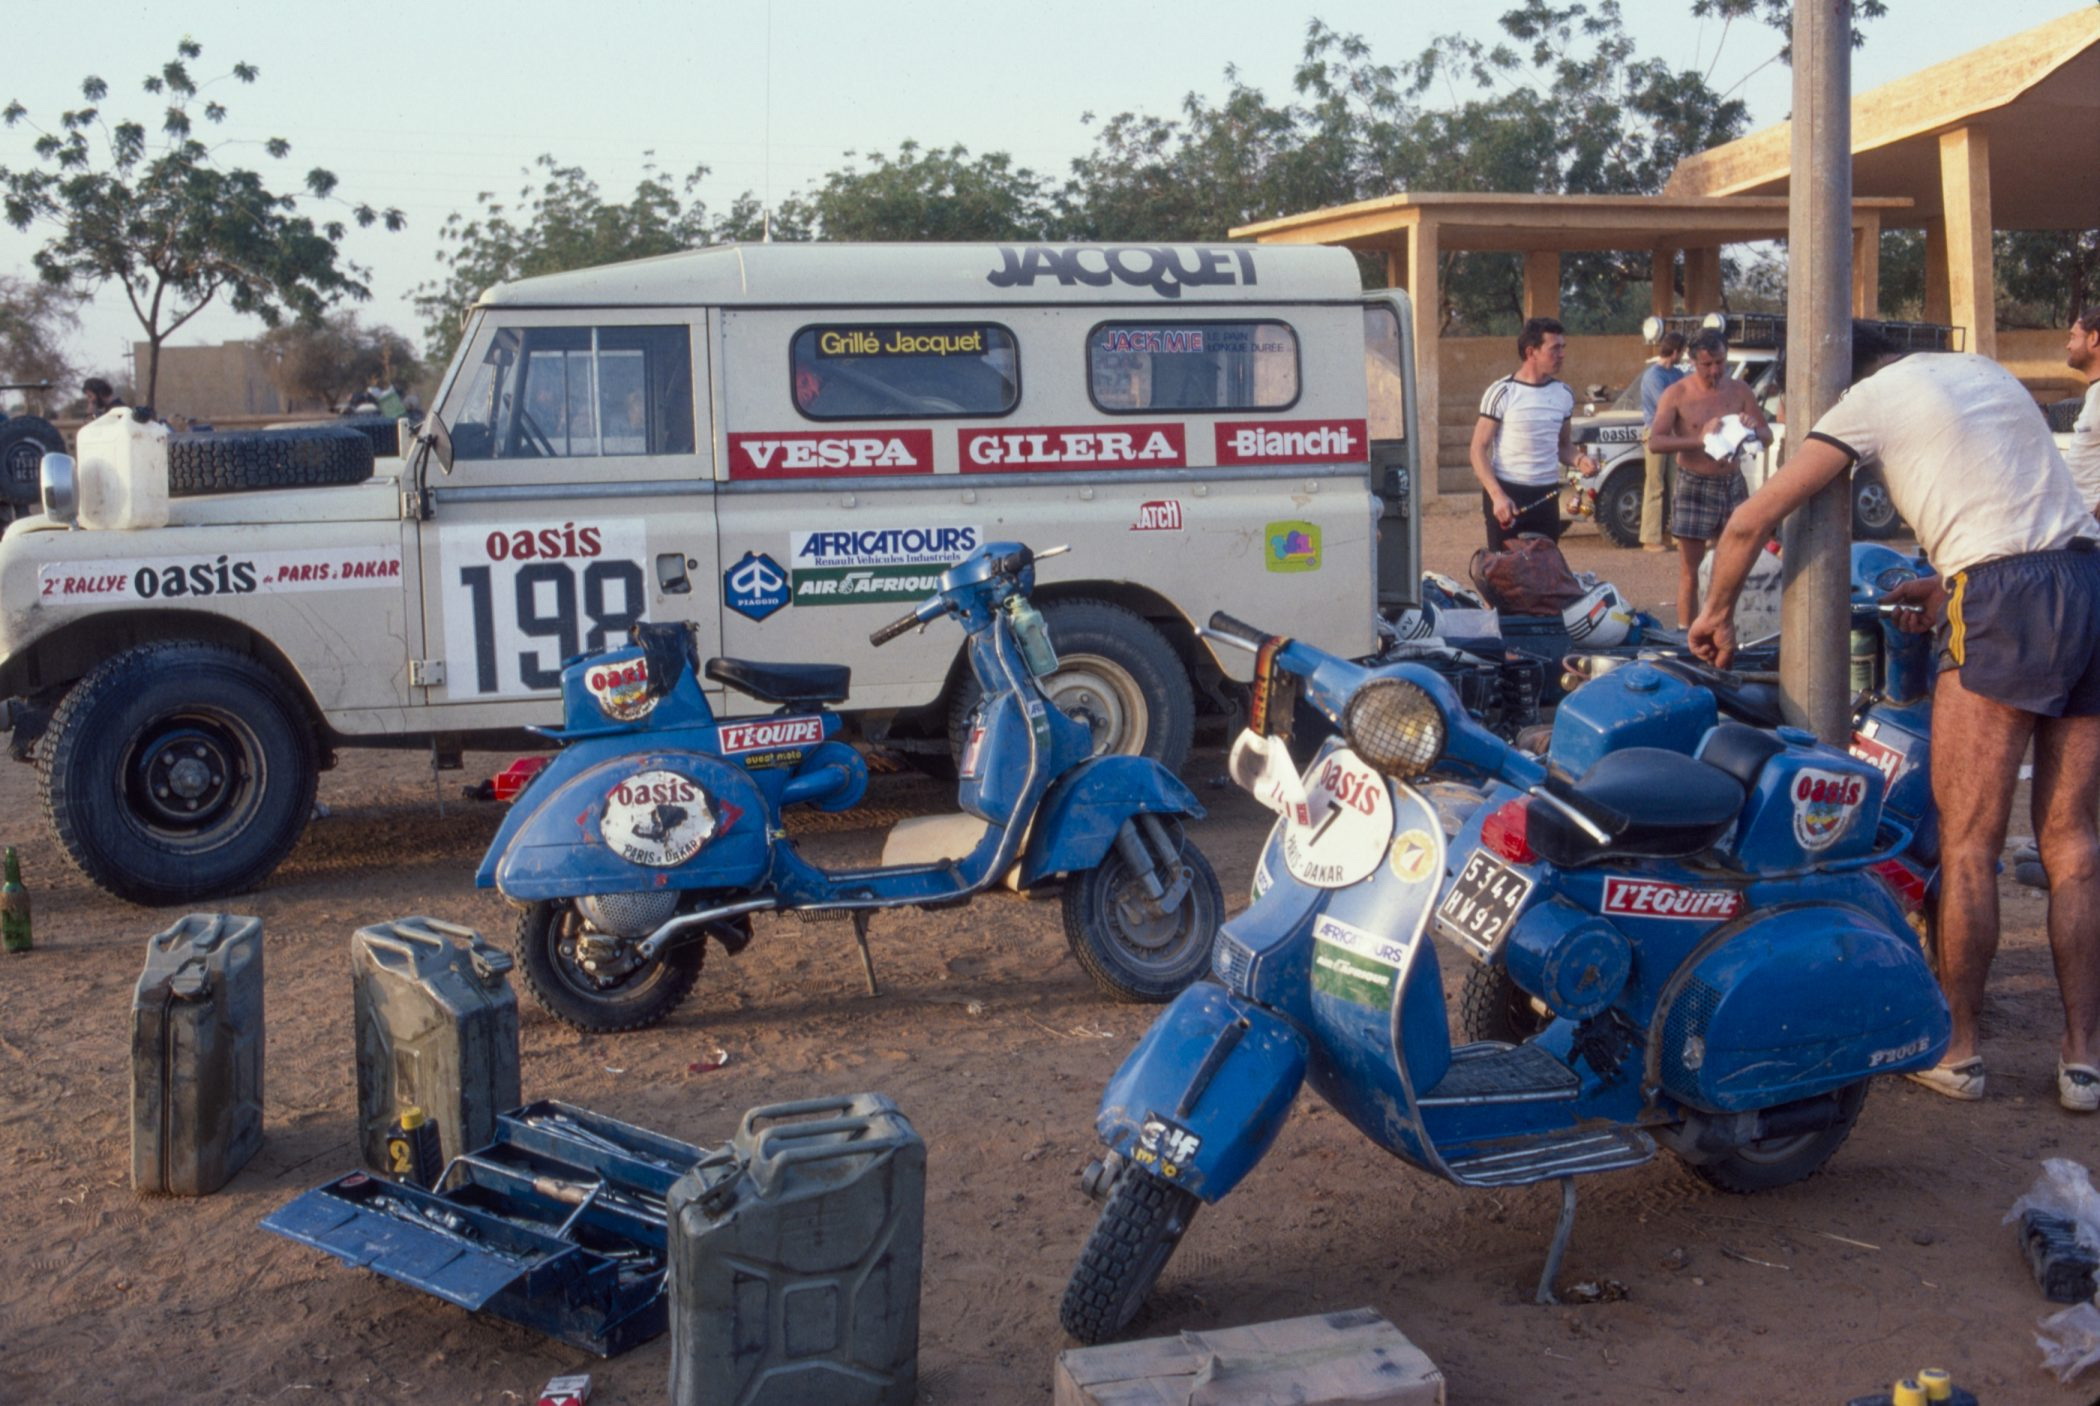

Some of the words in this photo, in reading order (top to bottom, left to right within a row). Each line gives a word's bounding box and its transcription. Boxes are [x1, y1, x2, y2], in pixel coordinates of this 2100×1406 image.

[986, 246, 1257, 298] JACQUET
[885, 330, 981, 356] Jacquet
[1101, 330, 1160, 353] JACK
[1163, 330, 1203, 353] MIE
[969, 431, 1177, 464] GILERA
[1235, 427, 1350, 457] Bianchi
[1602, 426, 1637, 440] oasis
[740, 438, 917, 469] VESPA
[486, 522, 602, 561] oasis
[799, 527, 976, 557] AFRICATOURS
[814, 556, 854, 567] Renault
[906, 552, 961, 563] Industriels
[63, 575, 128, 594] RALLYE
[134, 555, 257, 599] oasis
[278, 563, 330, 582] PARIS
[341, 560, 400, 579] DAKAR
[798, 580, 837, 595] AIR
[852, 575, 939, 594] AFRIQU
[738, 597, 779, 606] PIAGGIO
[460, 559, 645, 693] 198
[592, 660, 648, 691] oasi
[617, 778, 695, 806] oasis
[1320, 759, 1380, 816] oasis
[1797, 776, 1860, 805] oasis
[1308, 800, 1343, 847] 7
[623, 844, 655, 863] PARIS
[665, 840, 698, 862] DAKAR
[1303, 864, 1344, 882] DAKAR
[1465, 858, 1521, 908] 5344
[390, 1140, 413, 1173] 2
